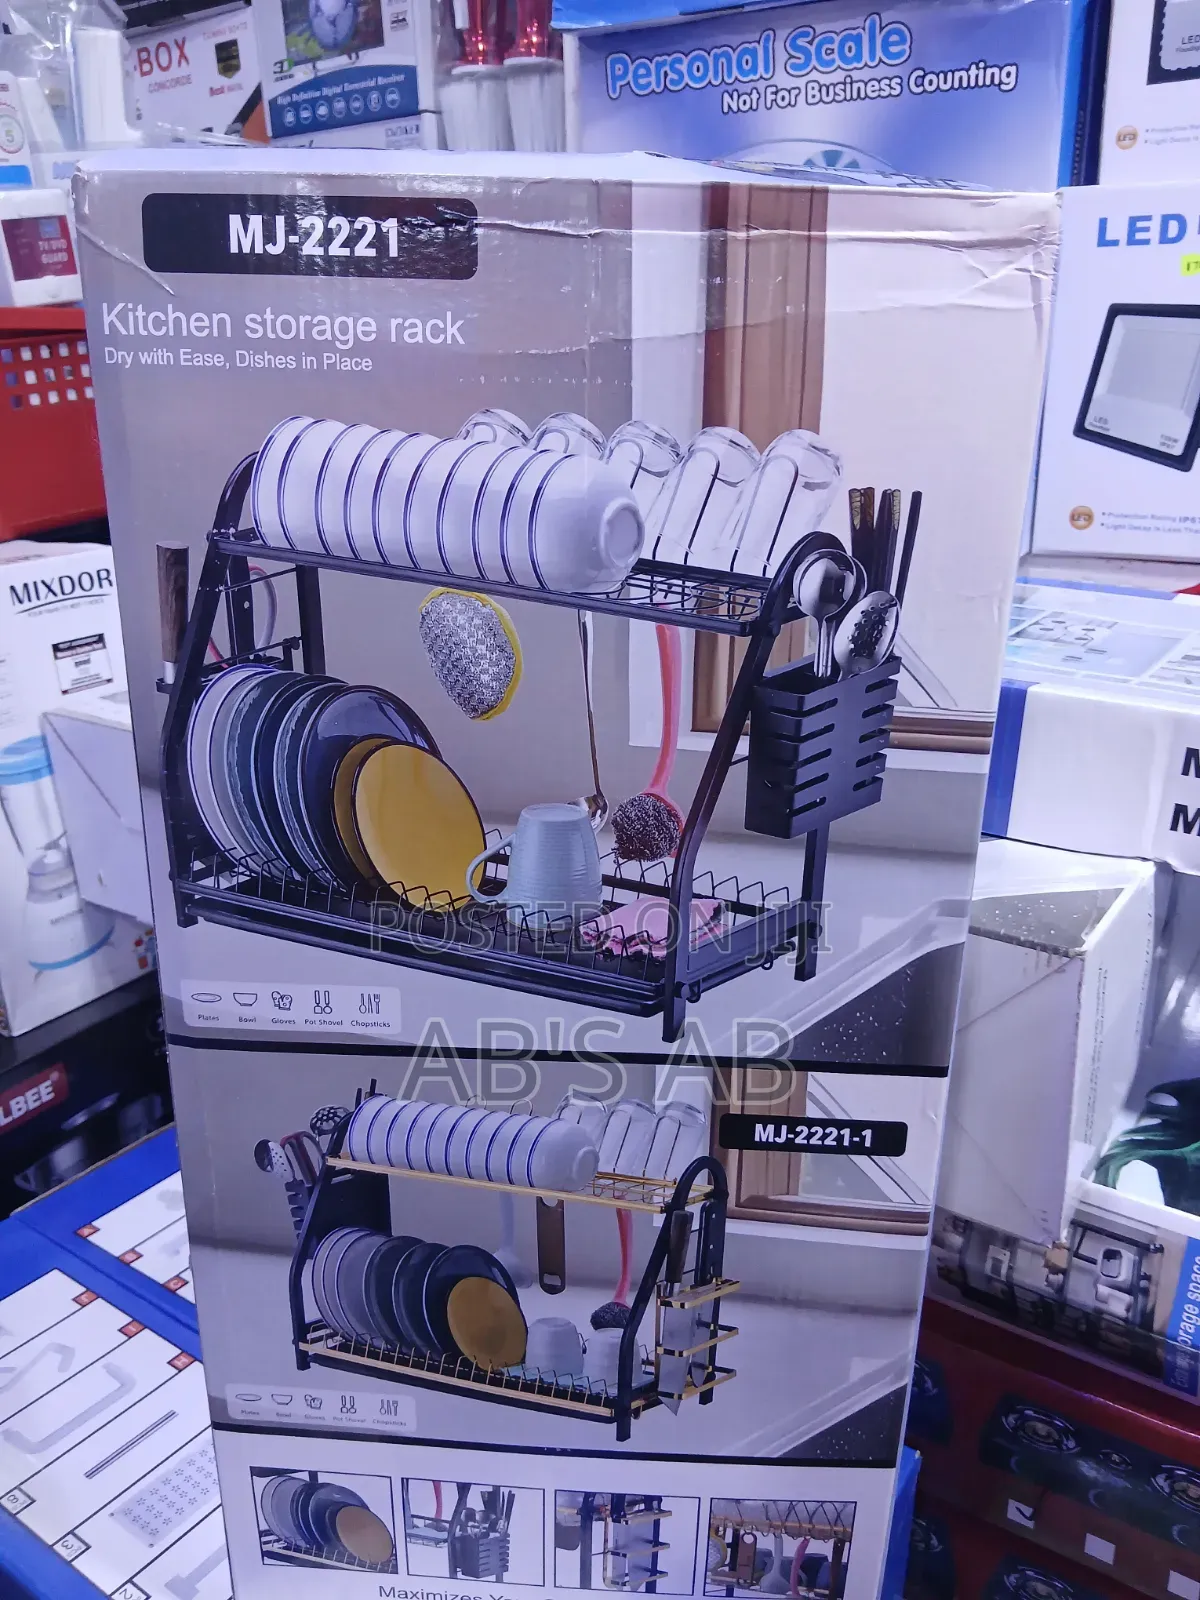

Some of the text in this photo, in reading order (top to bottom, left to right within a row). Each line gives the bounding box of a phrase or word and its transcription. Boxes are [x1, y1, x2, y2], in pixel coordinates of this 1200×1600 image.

[605, 12, 912, 100] Personal Scale
[722, 60, 1018, 114] Not For Business Counting
[229, 213, 399, 257] MJ-2221
[1096, 213, 1188, 248] LED
[102, 302, 465, 350] Kitchen storage rack
[104, 347, 373, 371] Dry with Ease, Dishes in Place
[9, 568, 114, 606] MIXDOR
[197, 1014, 219, 1022] Plates
[271, 1017, 296, 1025] Gloves
[304, 1018, 317, 1026] Pot
[318, 1018, 343, 1026] Shovel
[350, 1020, 391, 1028] Chopsticks
[754, 1123, 873, 1148] MJ-2221-1
[60, 1539, 74, 1550] 3
